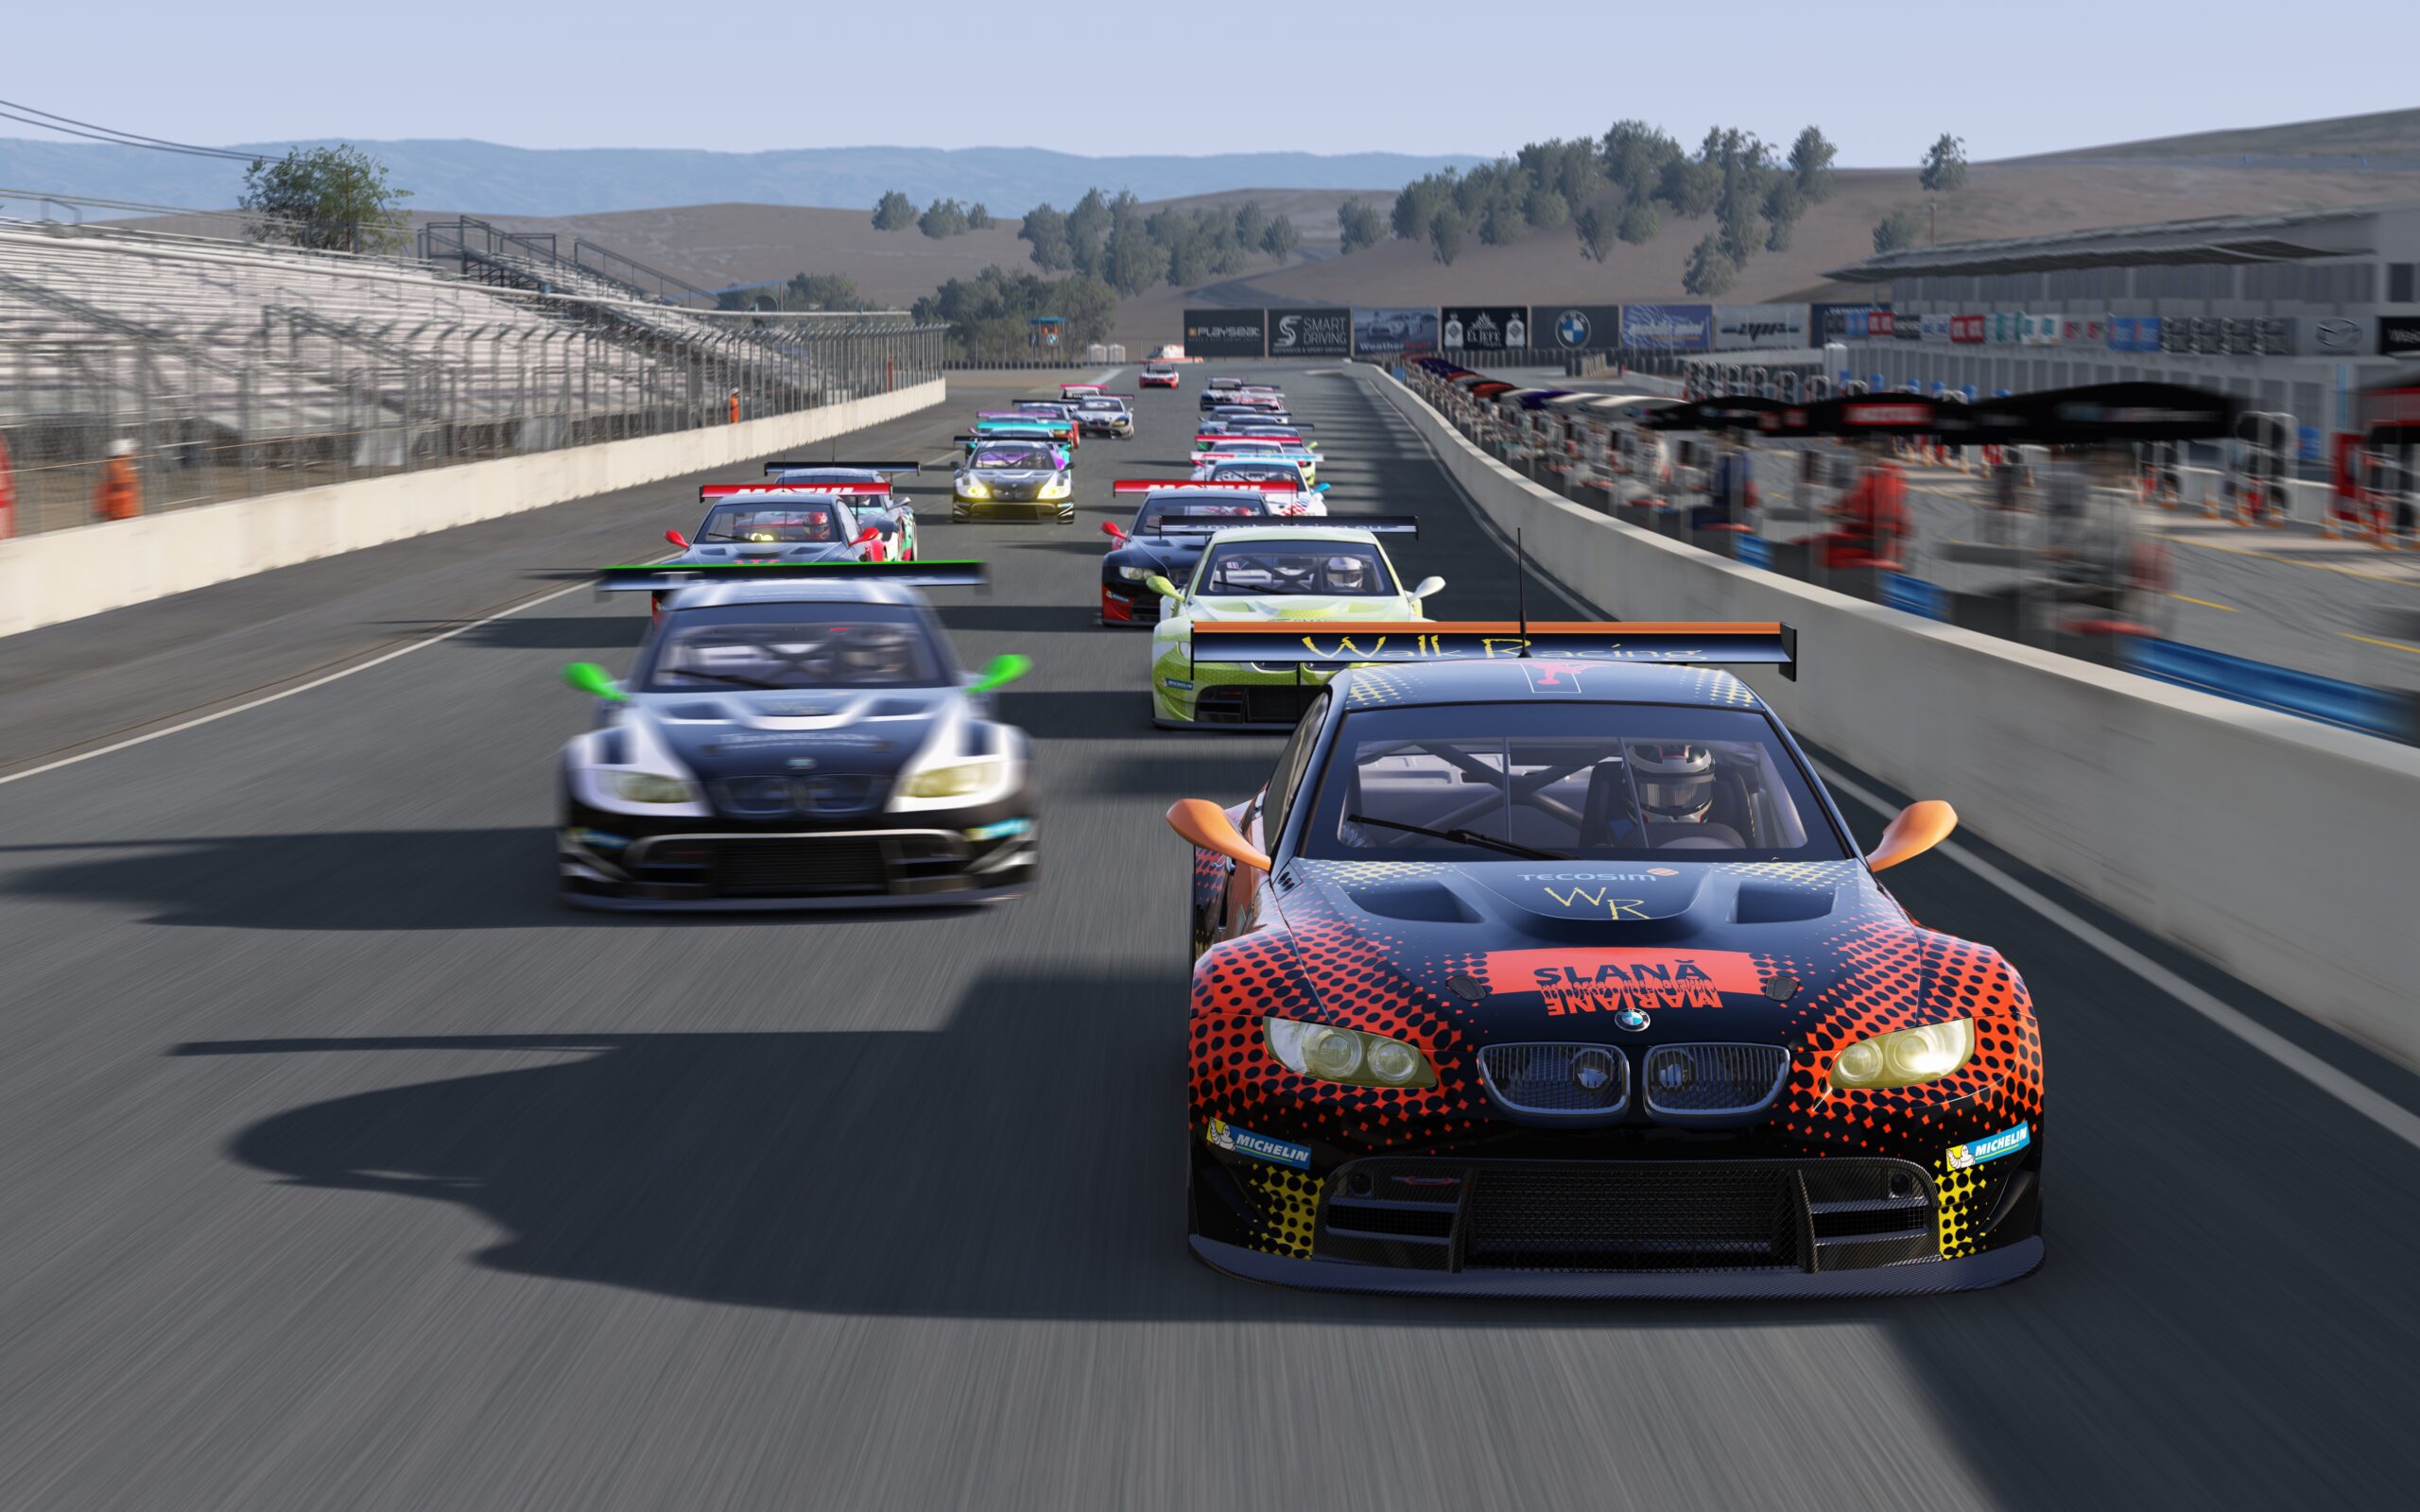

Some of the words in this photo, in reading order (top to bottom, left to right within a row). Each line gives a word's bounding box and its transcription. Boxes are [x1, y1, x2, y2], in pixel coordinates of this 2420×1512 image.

[1304, 317, 1347, 331] SMART
[1304, 332, 1347, 345] DRIVING
[1301, 635, 1467, 659] Walk
[1482, 637, 1708, 662] Racing
[1236, 1133, 1309, 1162] MICHELIN
[1974, 1126, 2028, 1157] MICHELIN
